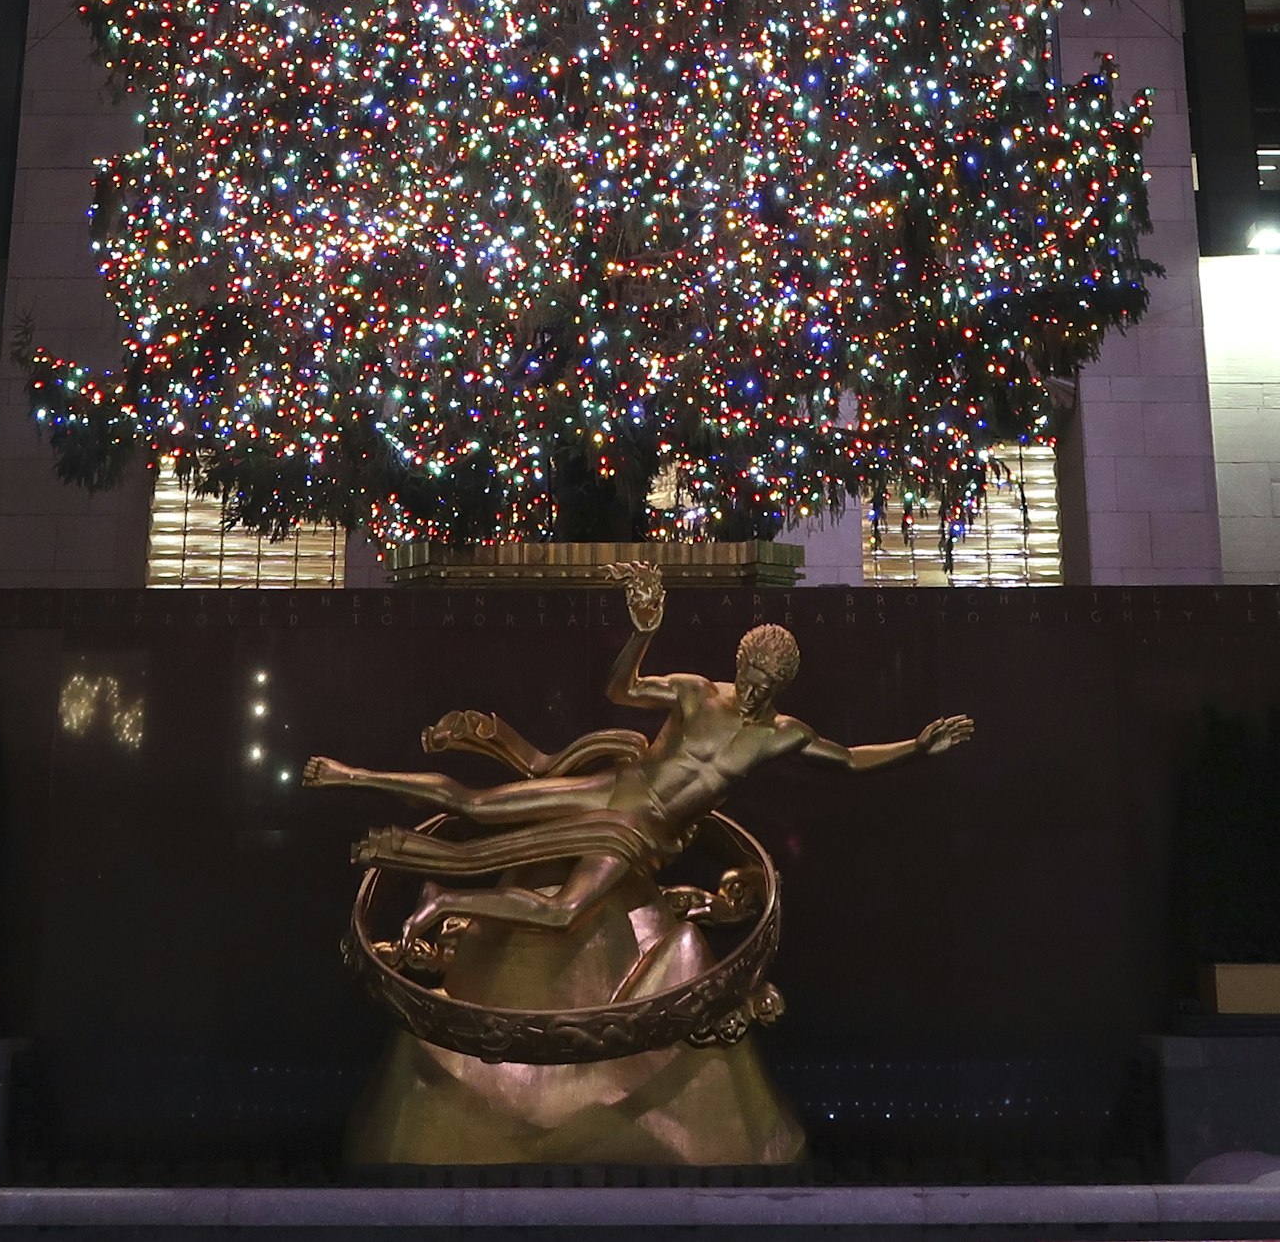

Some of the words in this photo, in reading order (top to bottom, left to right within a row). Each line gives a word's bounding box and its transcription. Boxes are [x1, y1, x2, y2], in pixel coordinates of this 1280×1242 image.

[447, 595, 486, 608] IN
[722, 594, 793, 606] ART
[352, 614, 393, 626] TO
[442, 613, 610, 626] MORTAL
[753, 613, 887, 625] MEANS
[939, 612, 980, 624] TO
